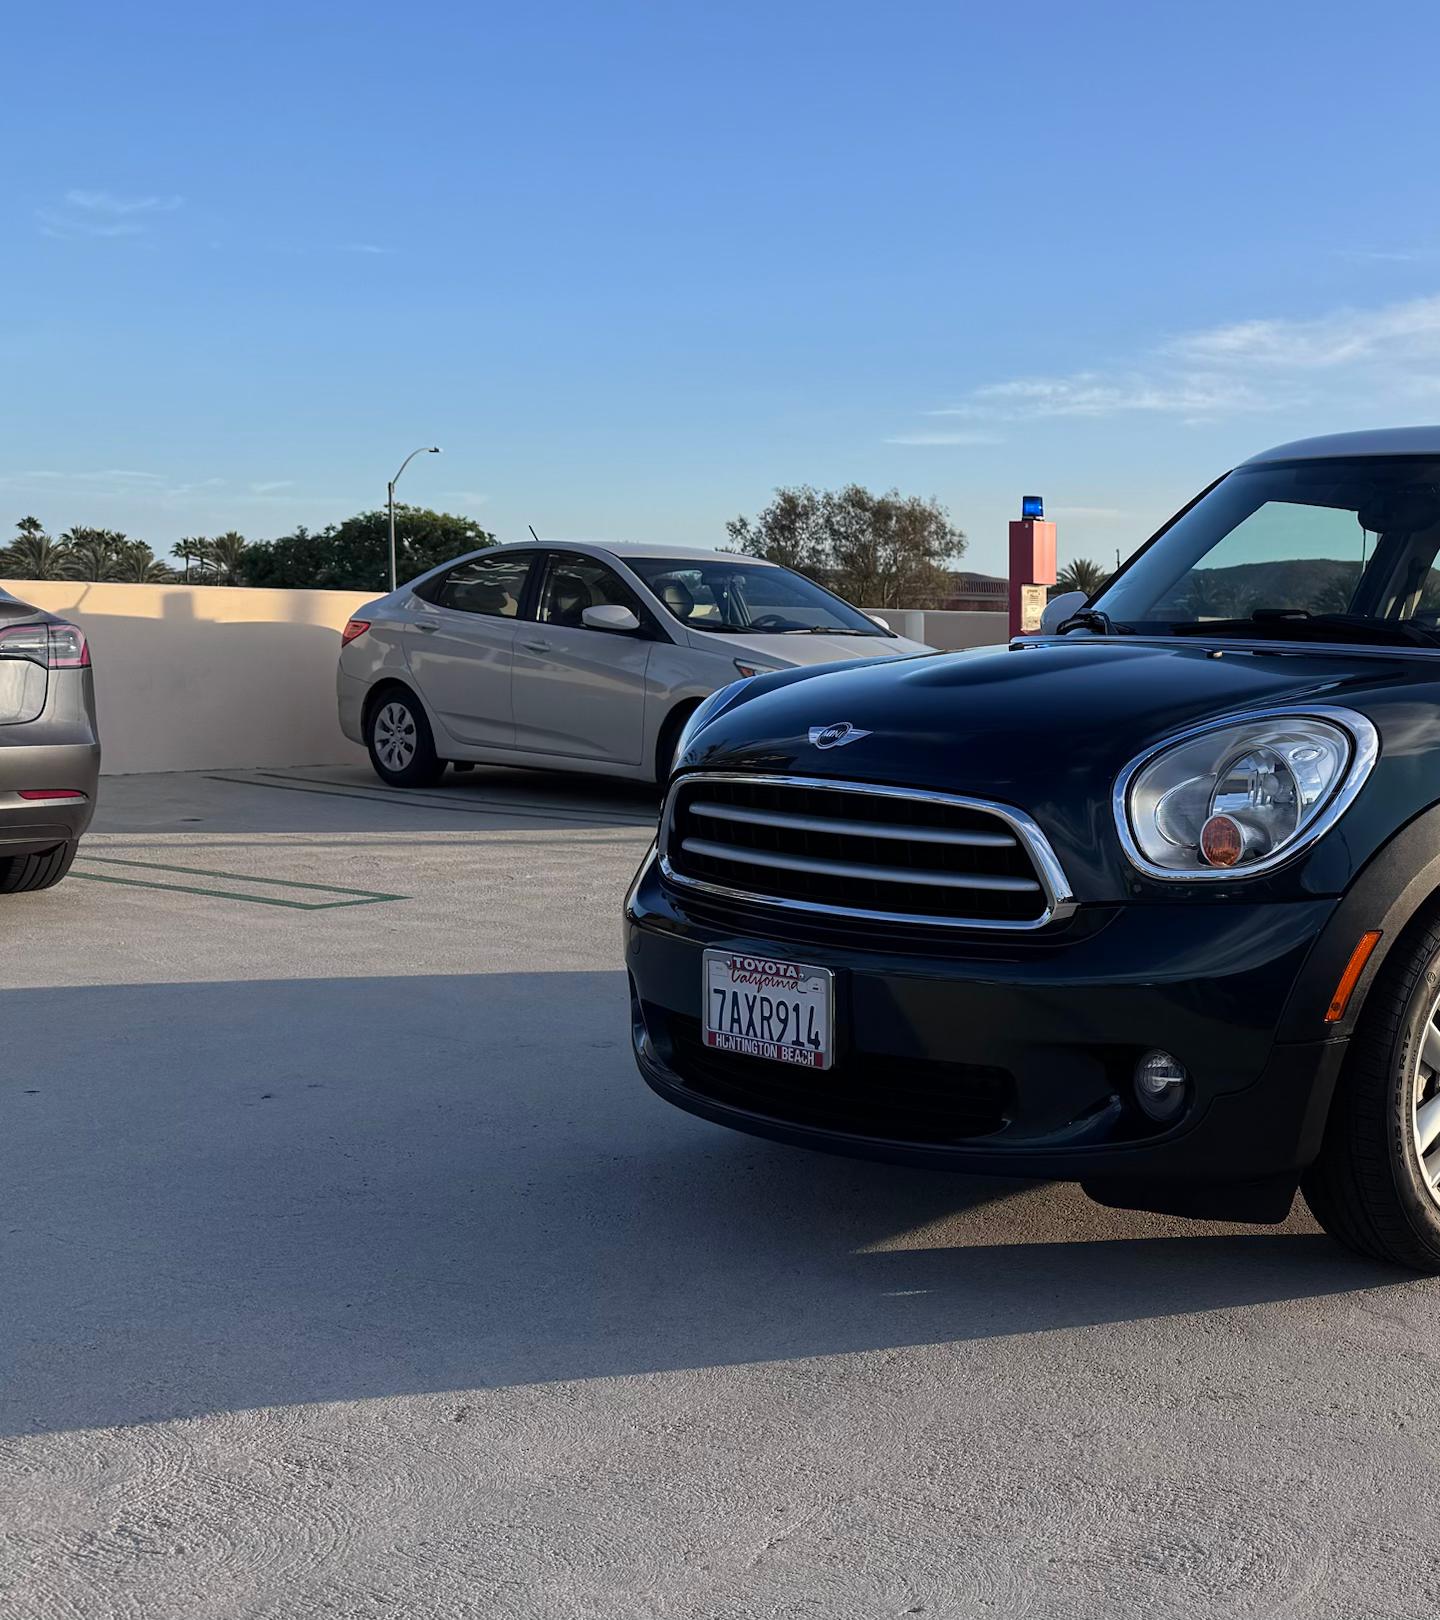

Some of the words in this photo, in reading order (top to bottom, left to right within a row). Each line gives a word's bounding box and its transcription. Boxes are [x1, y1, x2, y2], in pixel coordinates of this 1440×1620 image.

[733, 956, 798, 978] TOYOTA
[713, 988, 821, 1050] 7AXR914
[715, 1033, 778, 1058] HUNTINGTON
[781, 1050, 815, 1066] BEACH
